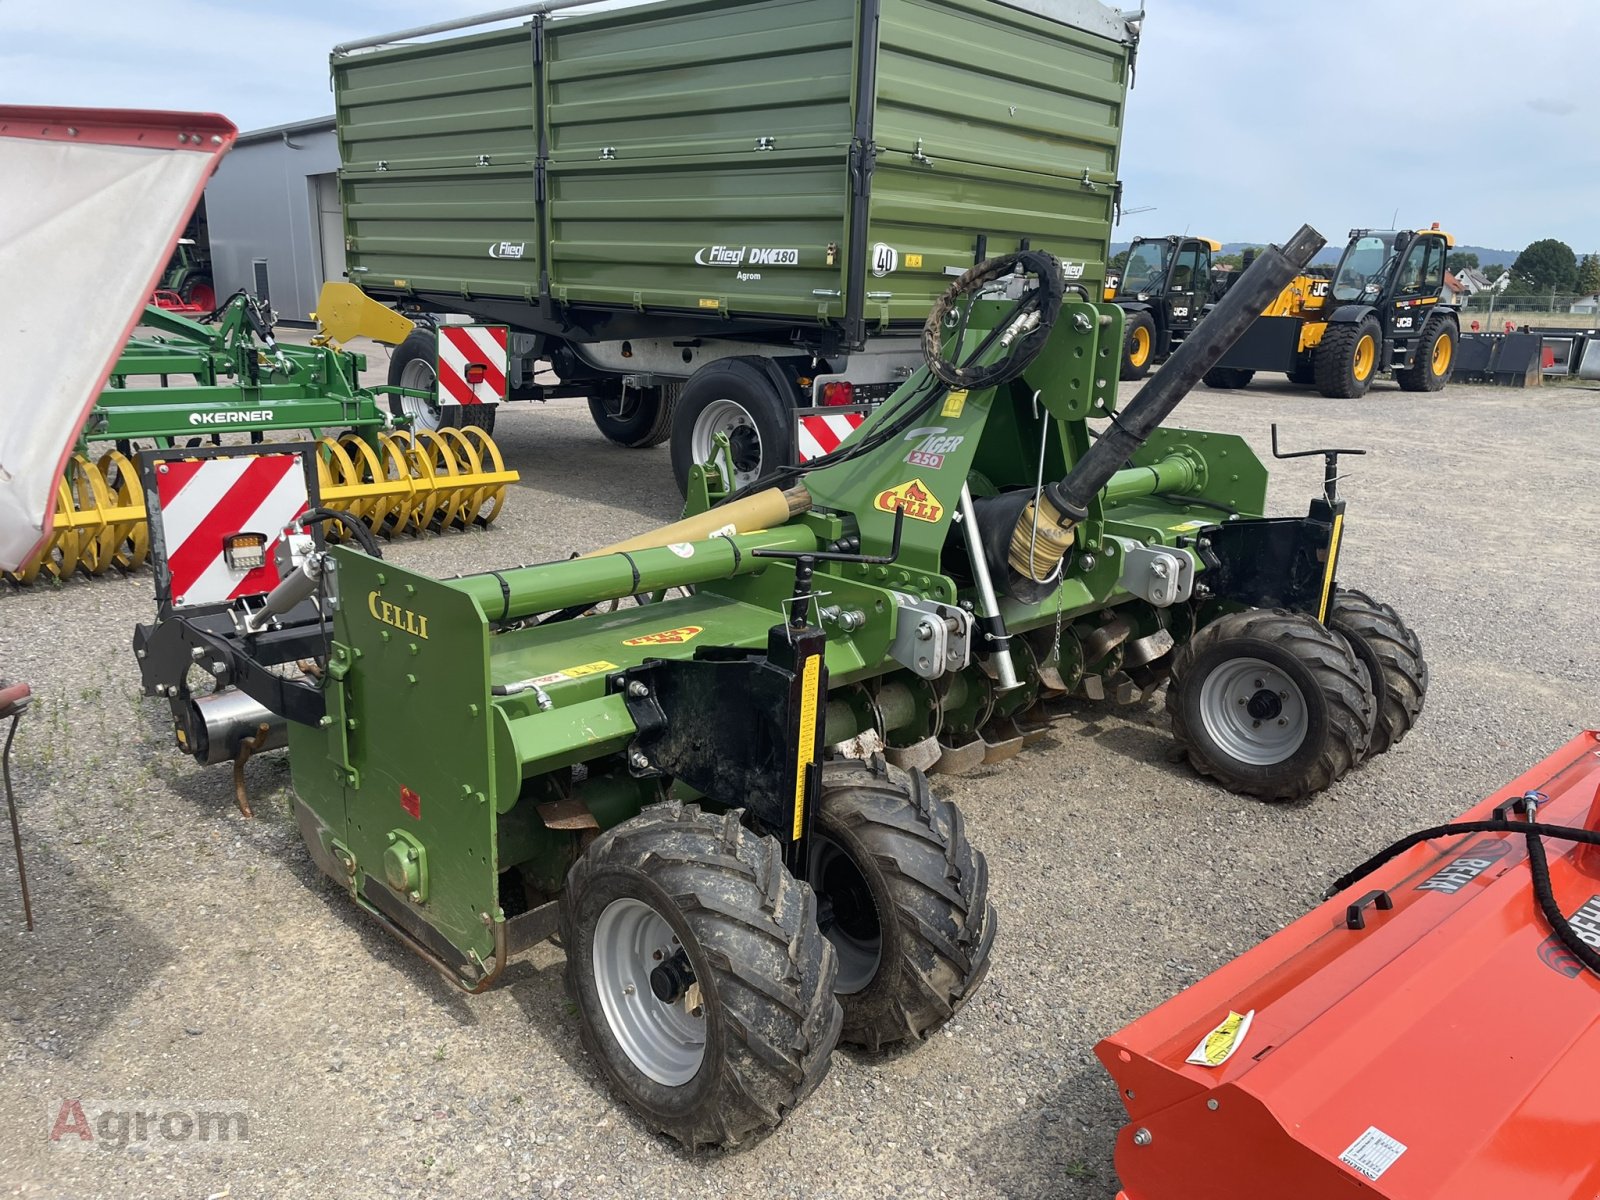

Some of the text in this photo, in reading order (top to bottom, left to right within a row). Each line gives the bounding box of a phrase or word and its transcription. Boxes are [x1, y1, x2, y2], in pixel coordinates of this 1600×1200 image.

[499, 241, 525, 258] Fliegl
[708, 246, 746, 265] Fliegl
[876, 248, 892, 272] 40
[736, 270, 761, 282] Agrom
[1104, 275, 1119, 289] JC
[1312, 282, 1329, 297] JC
[1172, 307, 1189, 317] JCB
[1396, 317, 1413, 328] JCB
[202, 410, 274, 424] KERNER
[903, 426, 964, 460] TIGER
[912, 453, 939, 467] 250
[879, 490, 941, 521] CELLI
[368, 590, 429, 640] CELLI
[1416, 857, 1492, 893] BEHA
[1569, 898, 1600, 948] BEH
